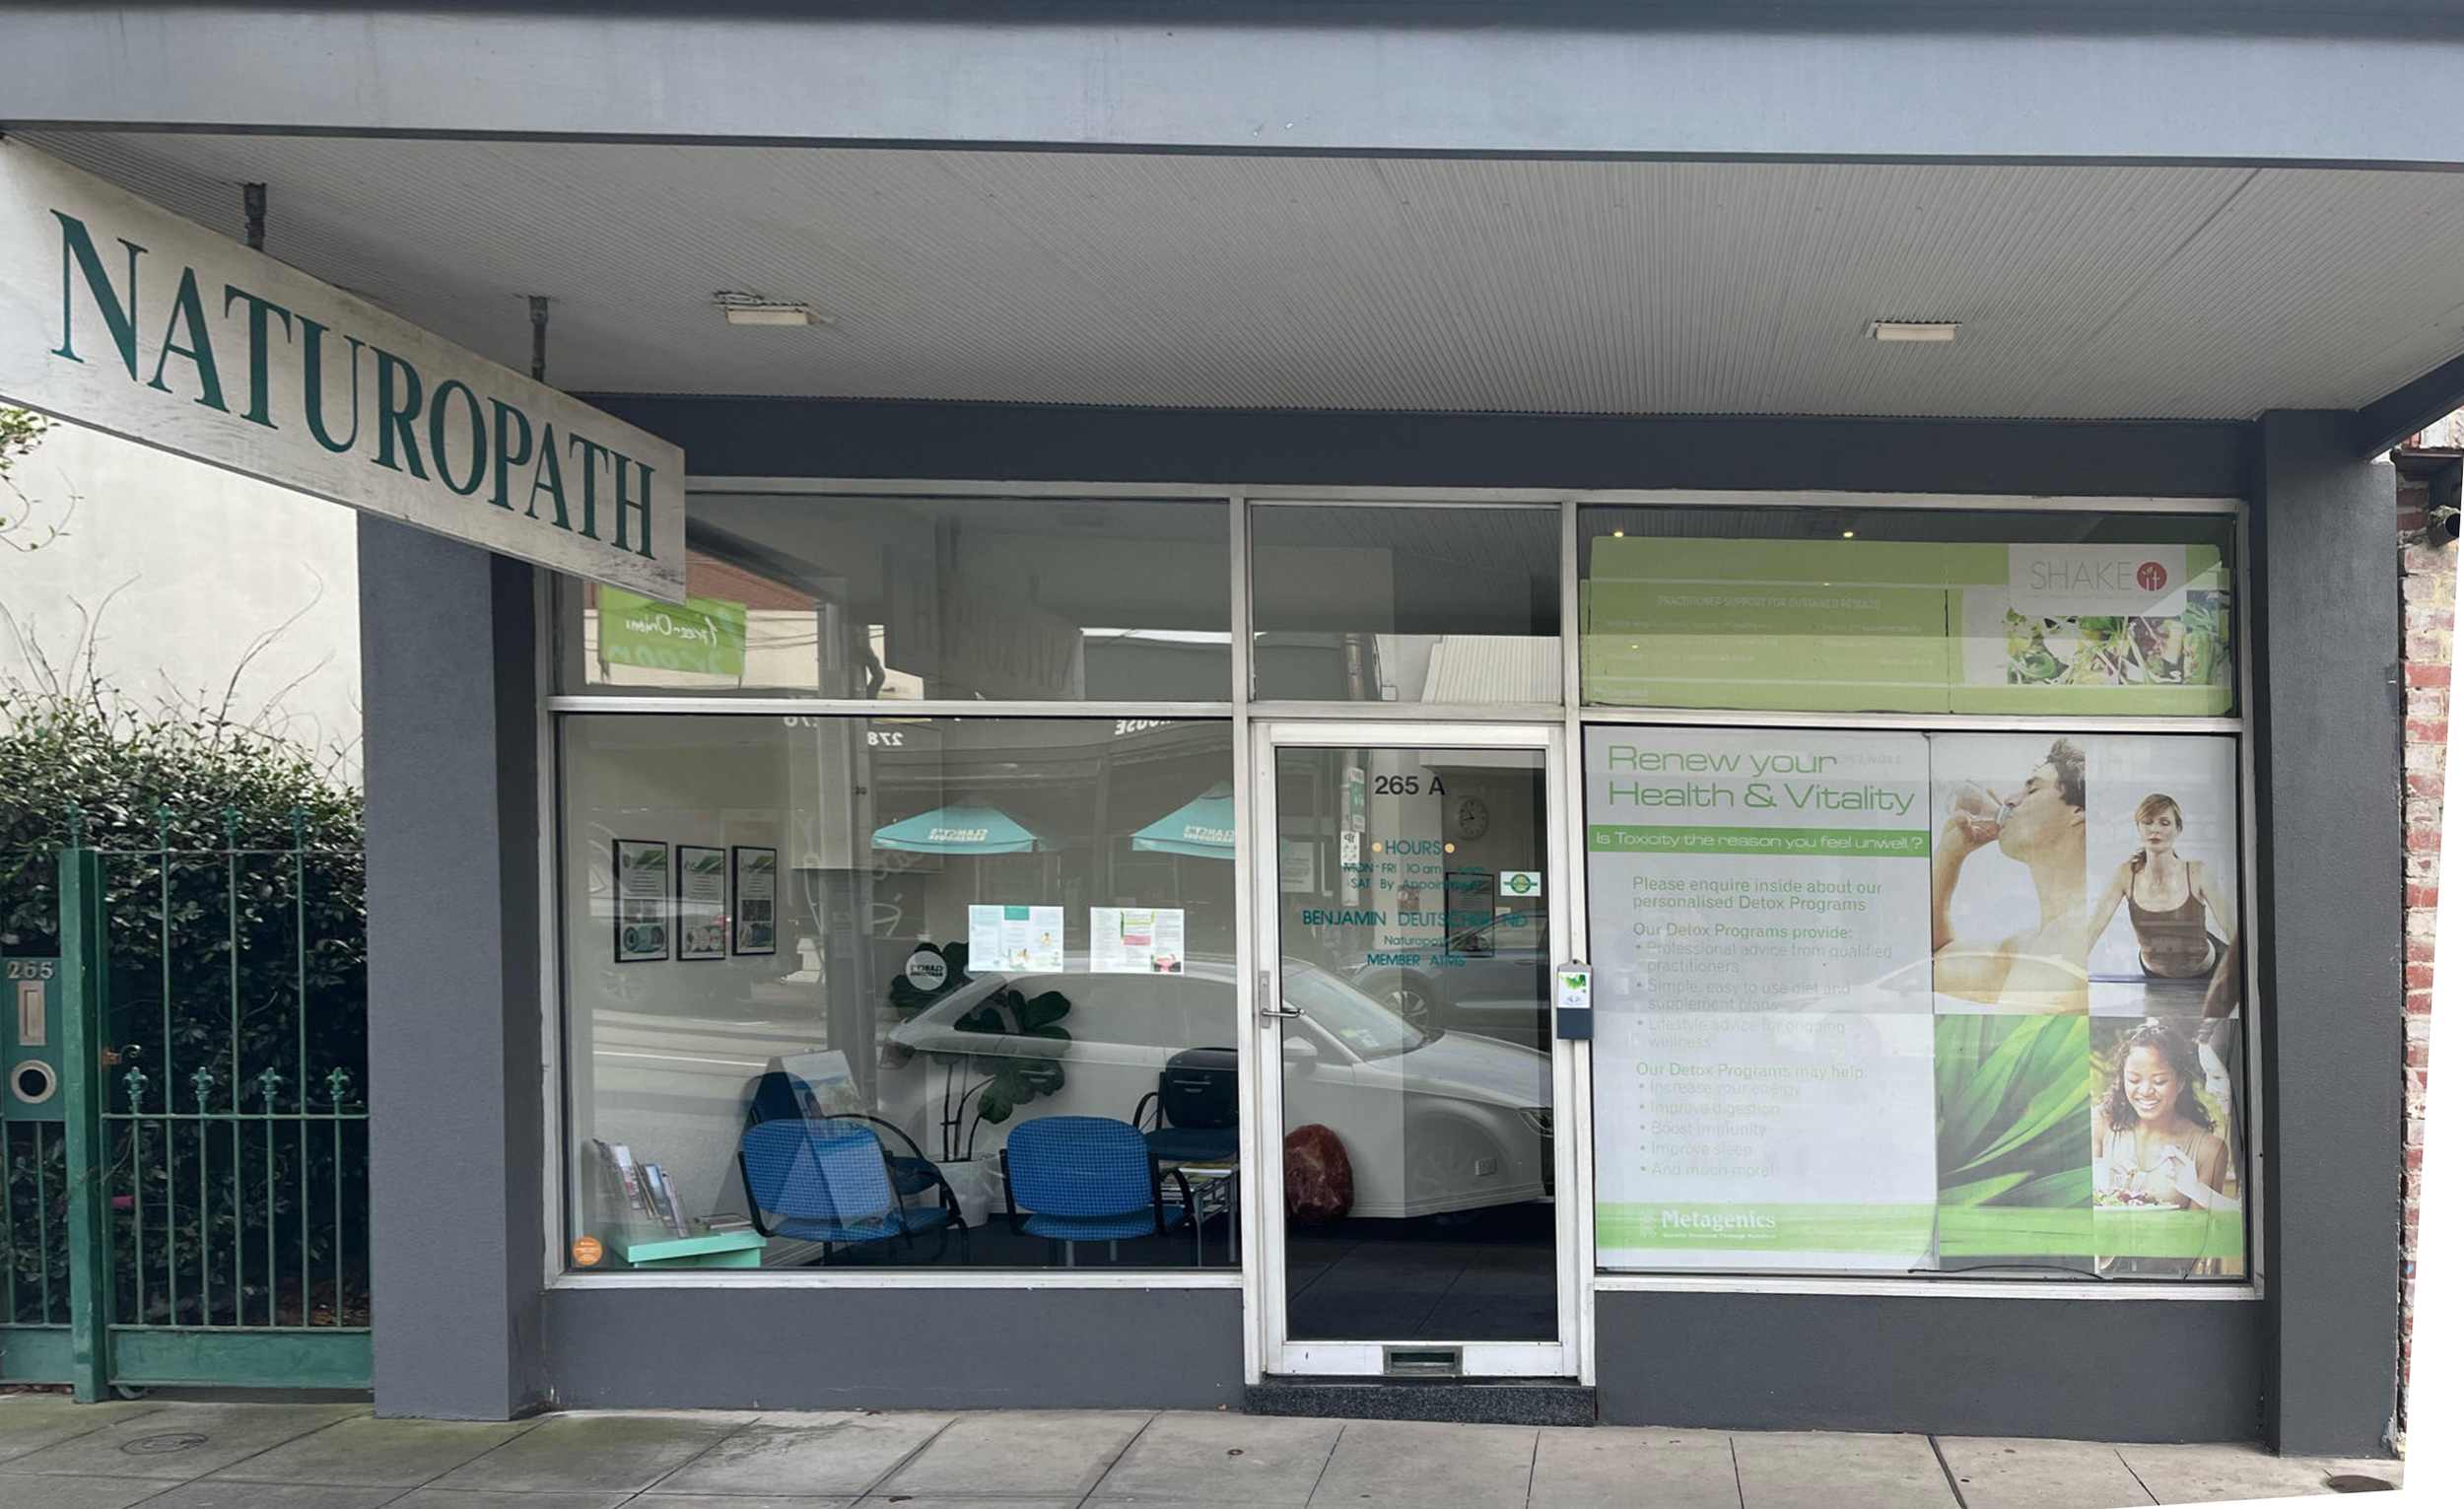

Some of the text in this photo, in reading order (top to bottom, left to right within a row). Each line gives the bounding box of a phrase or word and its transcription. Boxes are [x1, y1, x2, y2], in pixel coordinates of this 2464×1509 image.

[49, 208, 656, 561] NATUROPATH
[2029, 561, 2132, 590] SHAKE
[1658, 595, 1881, 611] PRACTITIONER SUPPORT FOR SUSTAINED RESULTS
[1608, 745, 1741, 772] Renew
[1748, 754, 1837, 778] your
[1374, 775, 1446, 796] 265 A
[1609, 781, 1916, 816] Health & Vitality
[1385, 840, 1443, 856] HOURS
[1596, 832, 1610, 845] Is
[1614, 832, 1679, 848] Toxicity
[1684, 833, 1715, 847] the
[1717, 837, 1781, 848] reason
[1785, 838, 1816, 851] you
[1820, 835, 1852, 849] feel
[1342, 861, 1373, 874] MON
[1381, 862, 1397, 874] FRI
[1350, 878, 1371, 889] SAT
[1380, 878, 1395, 892] By
[1633, 876, 1882, 895] Please enquire inside about our
[1633, 894, 1866, 913] personalised Detox Programs
[1302, 910, 1387, 926] BENJAMIN
[1633, 923, 1853, 940] Our Detox Programs provide:
[1648, 941, 1892, 961] Professional advice from qualified
[1367, 954, 1420, 967] MEMBER
[1648, 959, 1740, 976] practitioners
[7, 960, 54, 980] 265
[1706, 982, 1740, 995] easy
[1744, 982, 1758, 994] to
[1762, 984, 1787, 995] use
[1791, 981, 1819, 995] diet
[1824, 982, 1850, 996] and
[1648, 998, 1779, 1013] supplement plans
[1649, 1018, 1846, 1036] Lifestyle advice for ongoing
[1649, 1035, 1713, 1049] wellness
[1636, 1062, 1868, 1081] Our Detox Programs may help:
[1650, 1081, 1801, 1099] Increase your energy
[1650, 1101, 1780, 1118] Improve digestion
[1651, 1121, 1766, 1137] Boost immunity
[1651, 1142, 1752, 1157] Improve sleep
[1651, 1163, 1680, 1176] And
[1685, 1163, 1727, 1177] much
[1661, 1209, 1776, 1232] Metagenics
